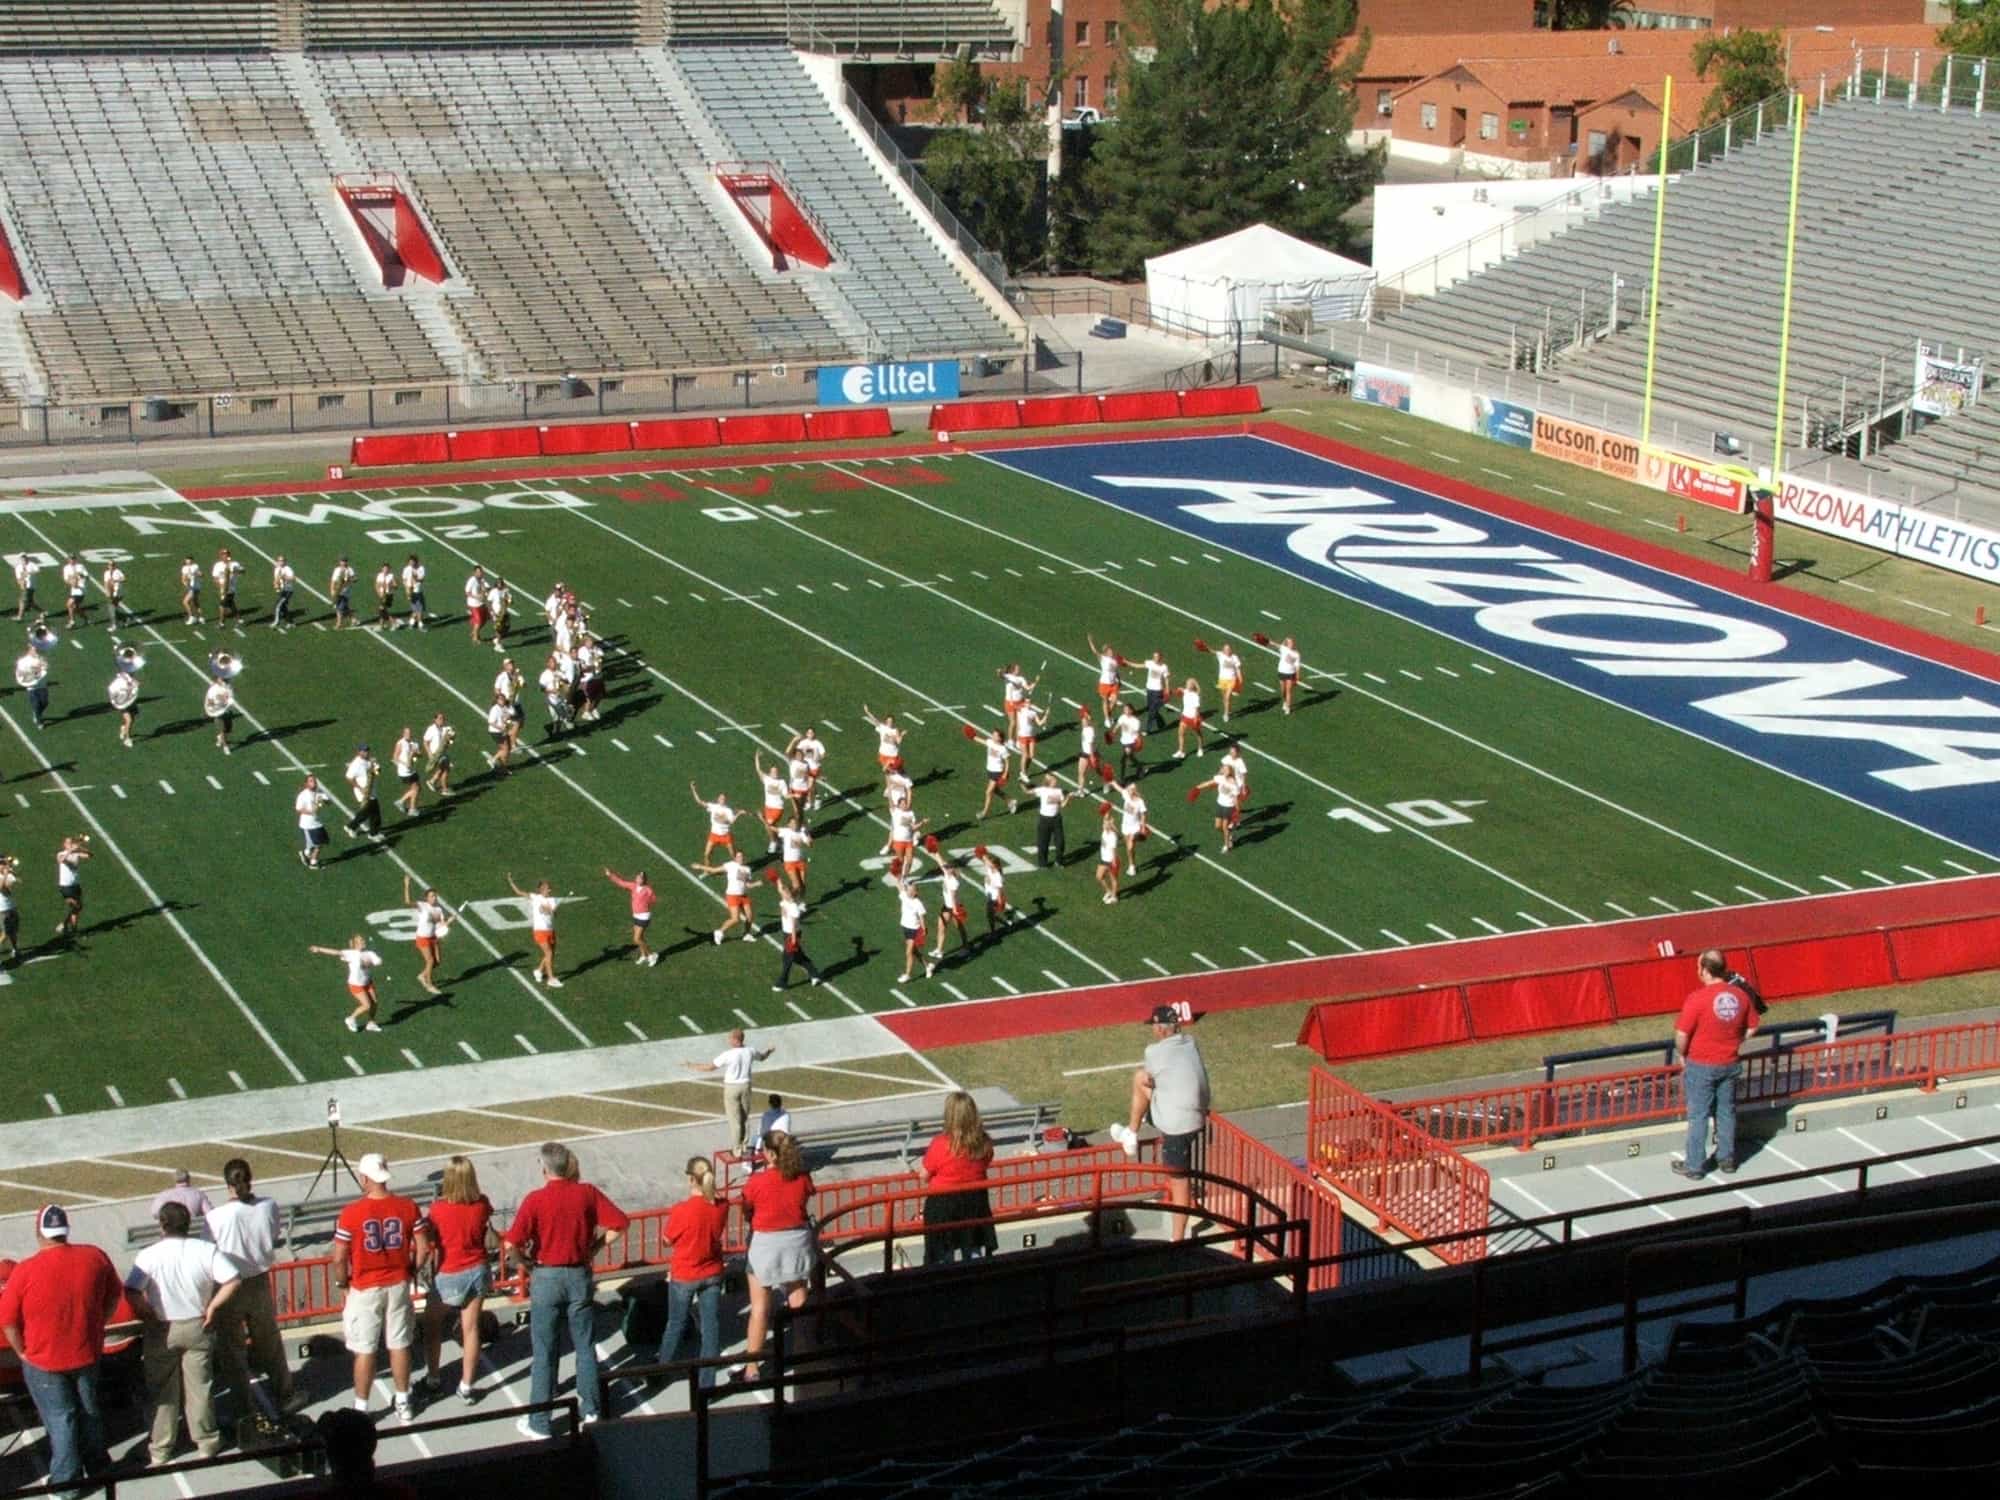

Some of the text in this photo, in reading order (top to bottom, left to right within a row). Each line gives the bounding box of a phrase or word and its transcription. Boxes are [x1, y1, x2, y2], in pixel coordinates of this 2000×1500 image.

[859, 362, 936, 395] alltel
[1536, 416, 1639, 465] tucson.com
[120, 490, 598, 535] DOWN
[1092, 473, 2000, 792] ARIZONA
[1327, 800, 1474, 833] 10
[365, 897, 538, 942] 30
[1657, 940, 1675, 957] 10
[362, 1216, 403, 1252] 32
